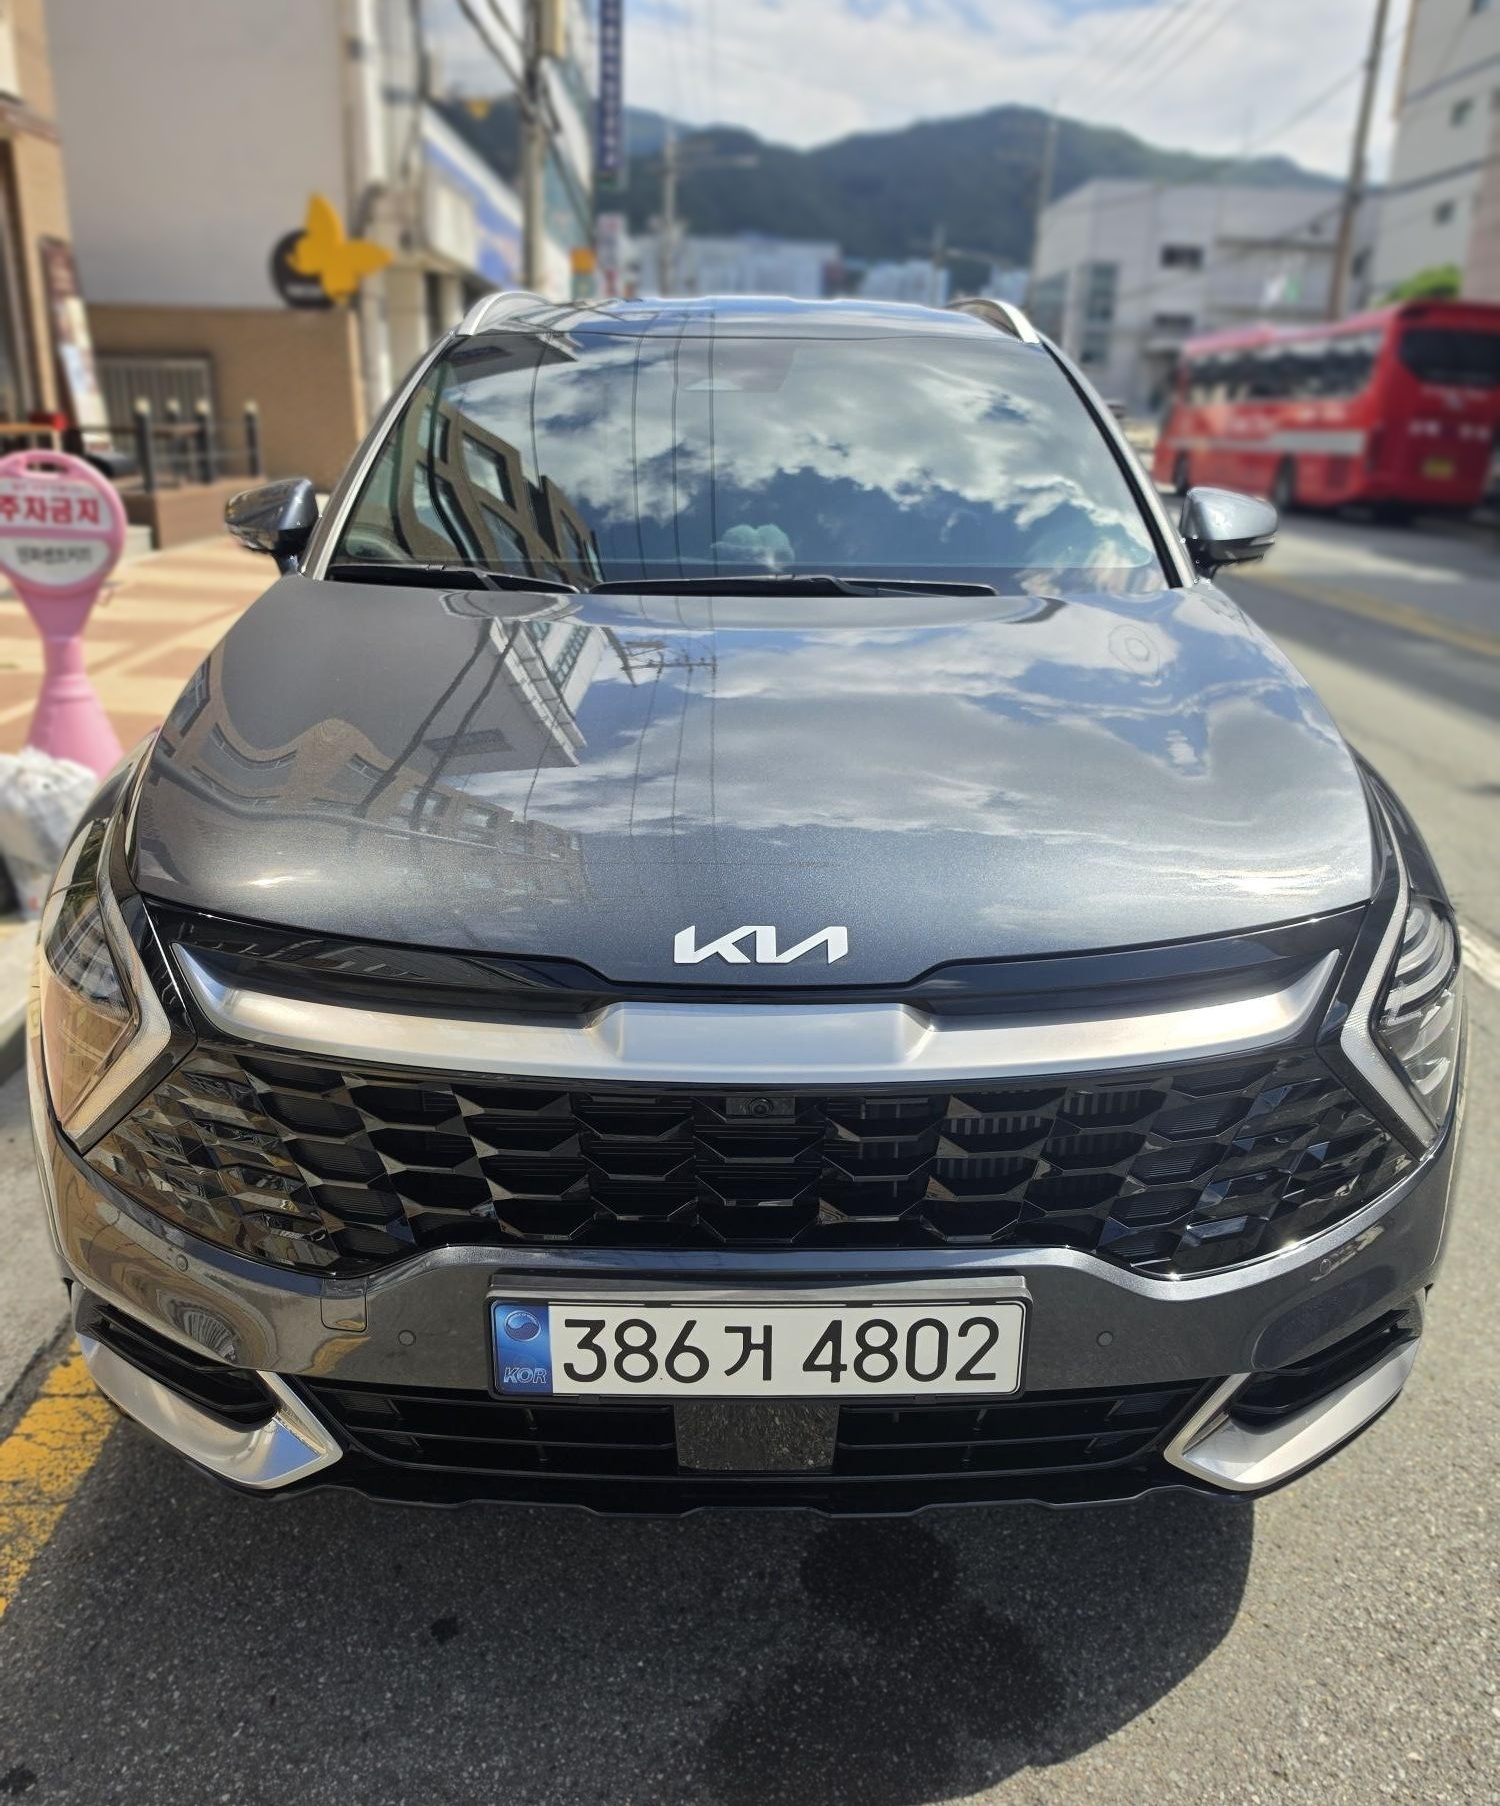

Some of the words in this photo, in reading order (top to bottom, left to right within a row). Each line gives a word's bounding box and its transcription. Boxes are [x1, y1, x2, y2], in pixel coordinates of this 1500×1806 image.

[674, 925, 848, 963] KIA
[563, 1319, 772, 1383] 386거
[802, 1317, 1000, 1383] 4802
[503, 1367, 547, 1384] KOR
